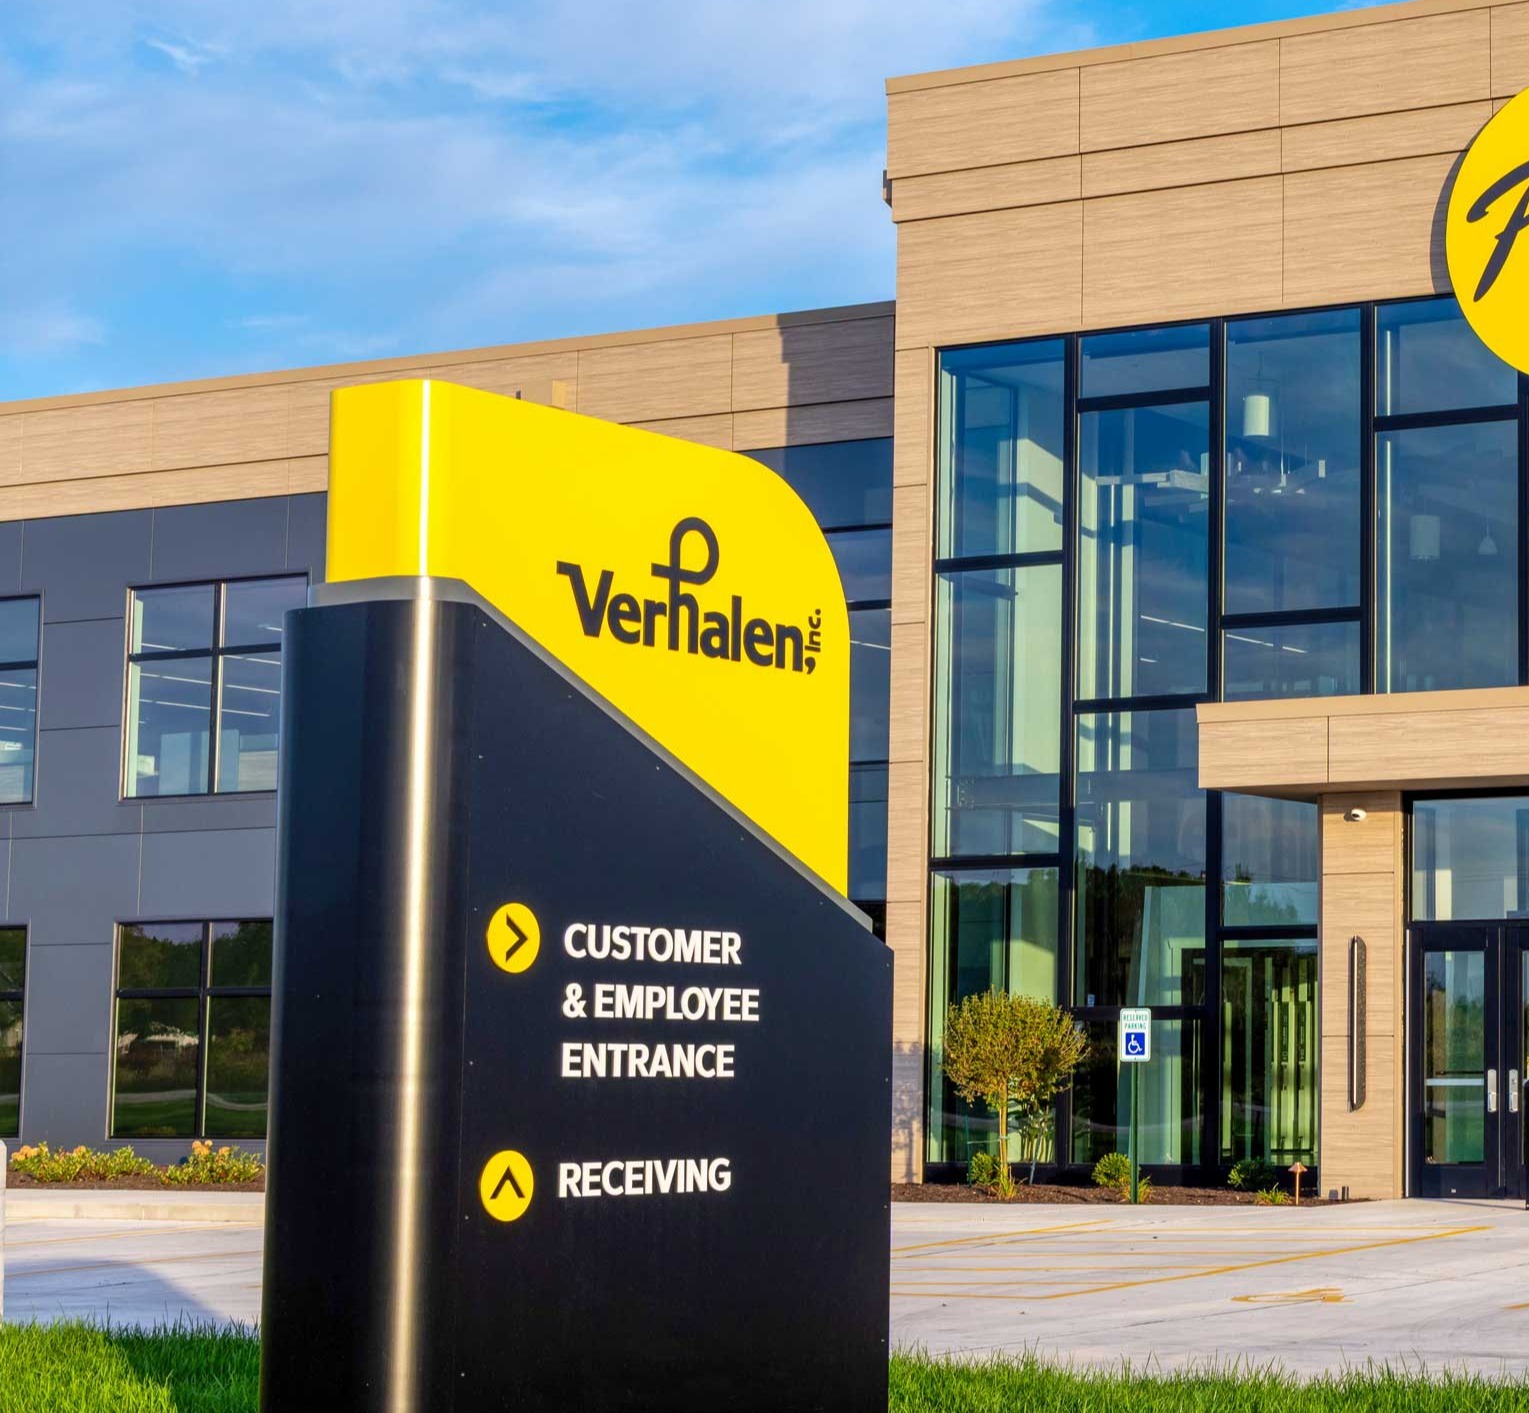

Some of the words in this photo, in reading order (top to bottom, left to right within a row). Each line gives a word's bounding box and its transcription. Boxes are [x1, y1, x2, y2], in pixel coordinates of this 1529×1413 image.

[804, 608, 822, 653] Inc.
[563, 923, 742, 965] CUSTOMER
[561, 983, 587, 1018] &
[594, 984, 760, 1022] EMPLOYEE
[1124, 1022, 1147, 1030] PARKING
[560, 1042, 735, 1078] ENTRANCE
[558, 1157, 732, 1198] RECEIVING
